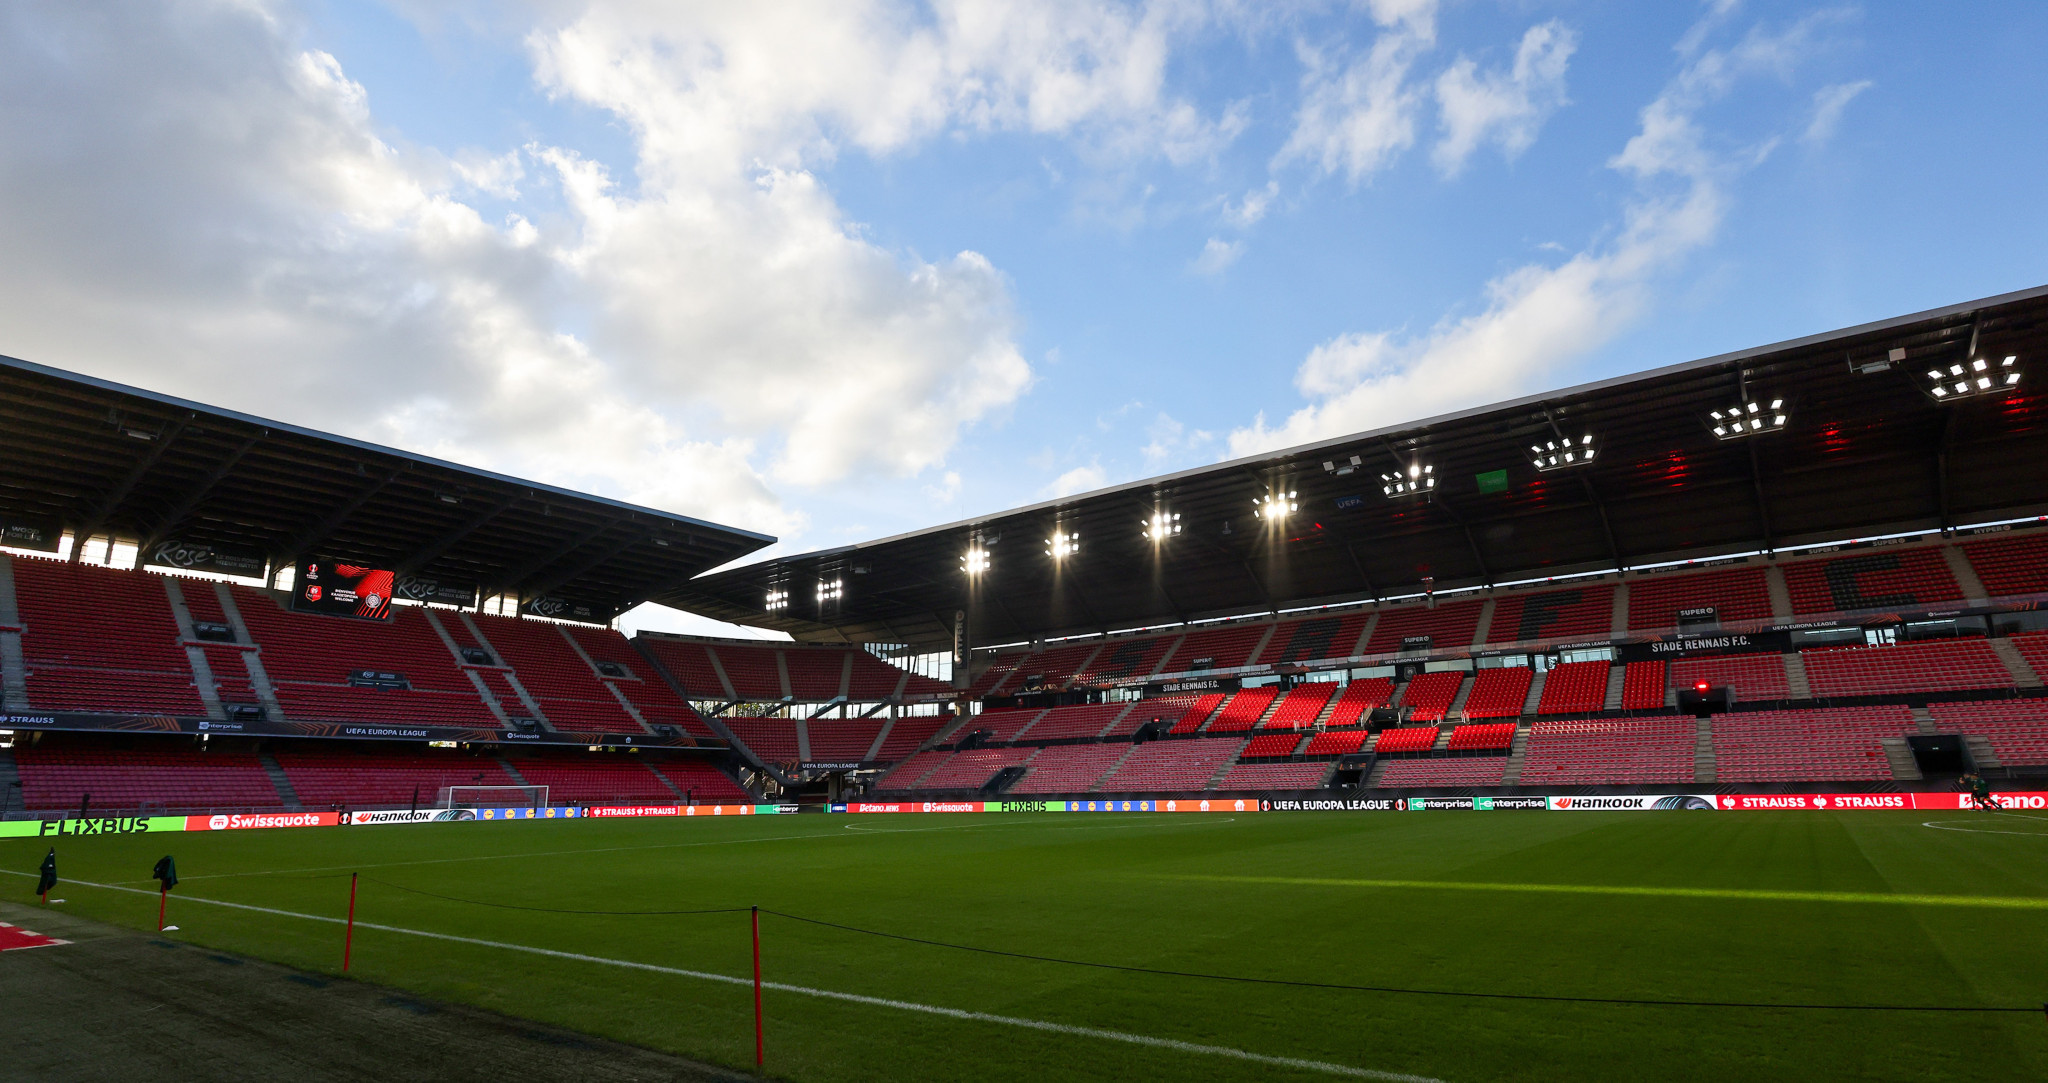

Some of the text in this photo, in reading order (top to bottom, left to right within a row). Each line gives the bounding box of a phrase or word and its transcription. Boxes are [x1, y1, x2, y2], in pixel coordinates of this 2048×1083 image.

[11, 526, 39, 534] WOOD
[1973, 526, 2003, 534] HYPER
[1872, 539, 1898, 547] SUPER
[154, 540, 210, 568] Rose
[1808, 546, 1832, 555] SUPER
[397, 575, 437, 599] Rose
[1517, 590, 1583, 640] F
[1825, 554, 1919, 611] C
[530, 594, 565, 616] Rose
[1680, 608, 1706, 616] SUPER
[1814, 620, 1838, 628] LEAGUE
[1652, 635, 1751, 653] STADE RENNAIS F.C.
[1162, 683, 1181, 692] STADE
[1181, 681, 1207, 691] RENNAIS
[9, 715, 55, 724] STRAUSS
[368, 728, 397, 736] EUROPA
[399, 729, 427, 737] LEAGUE
[1273, 799, 1390, 810] UEFA EUROPA LEAGUE
[1416, 799, 1473, 809] enterprise
[1483, 798, 1546, 809] enterprise
[1742, 796, 1904, 808] STRAUSS STRAUSS
[1958, 793, 2046, 809] Btano
[602, 807, 676, 816] STRAUSS STRAUSS
[931, 802, 973, 813] Swissquote
[230, 813, 320, 828] Swissquote
